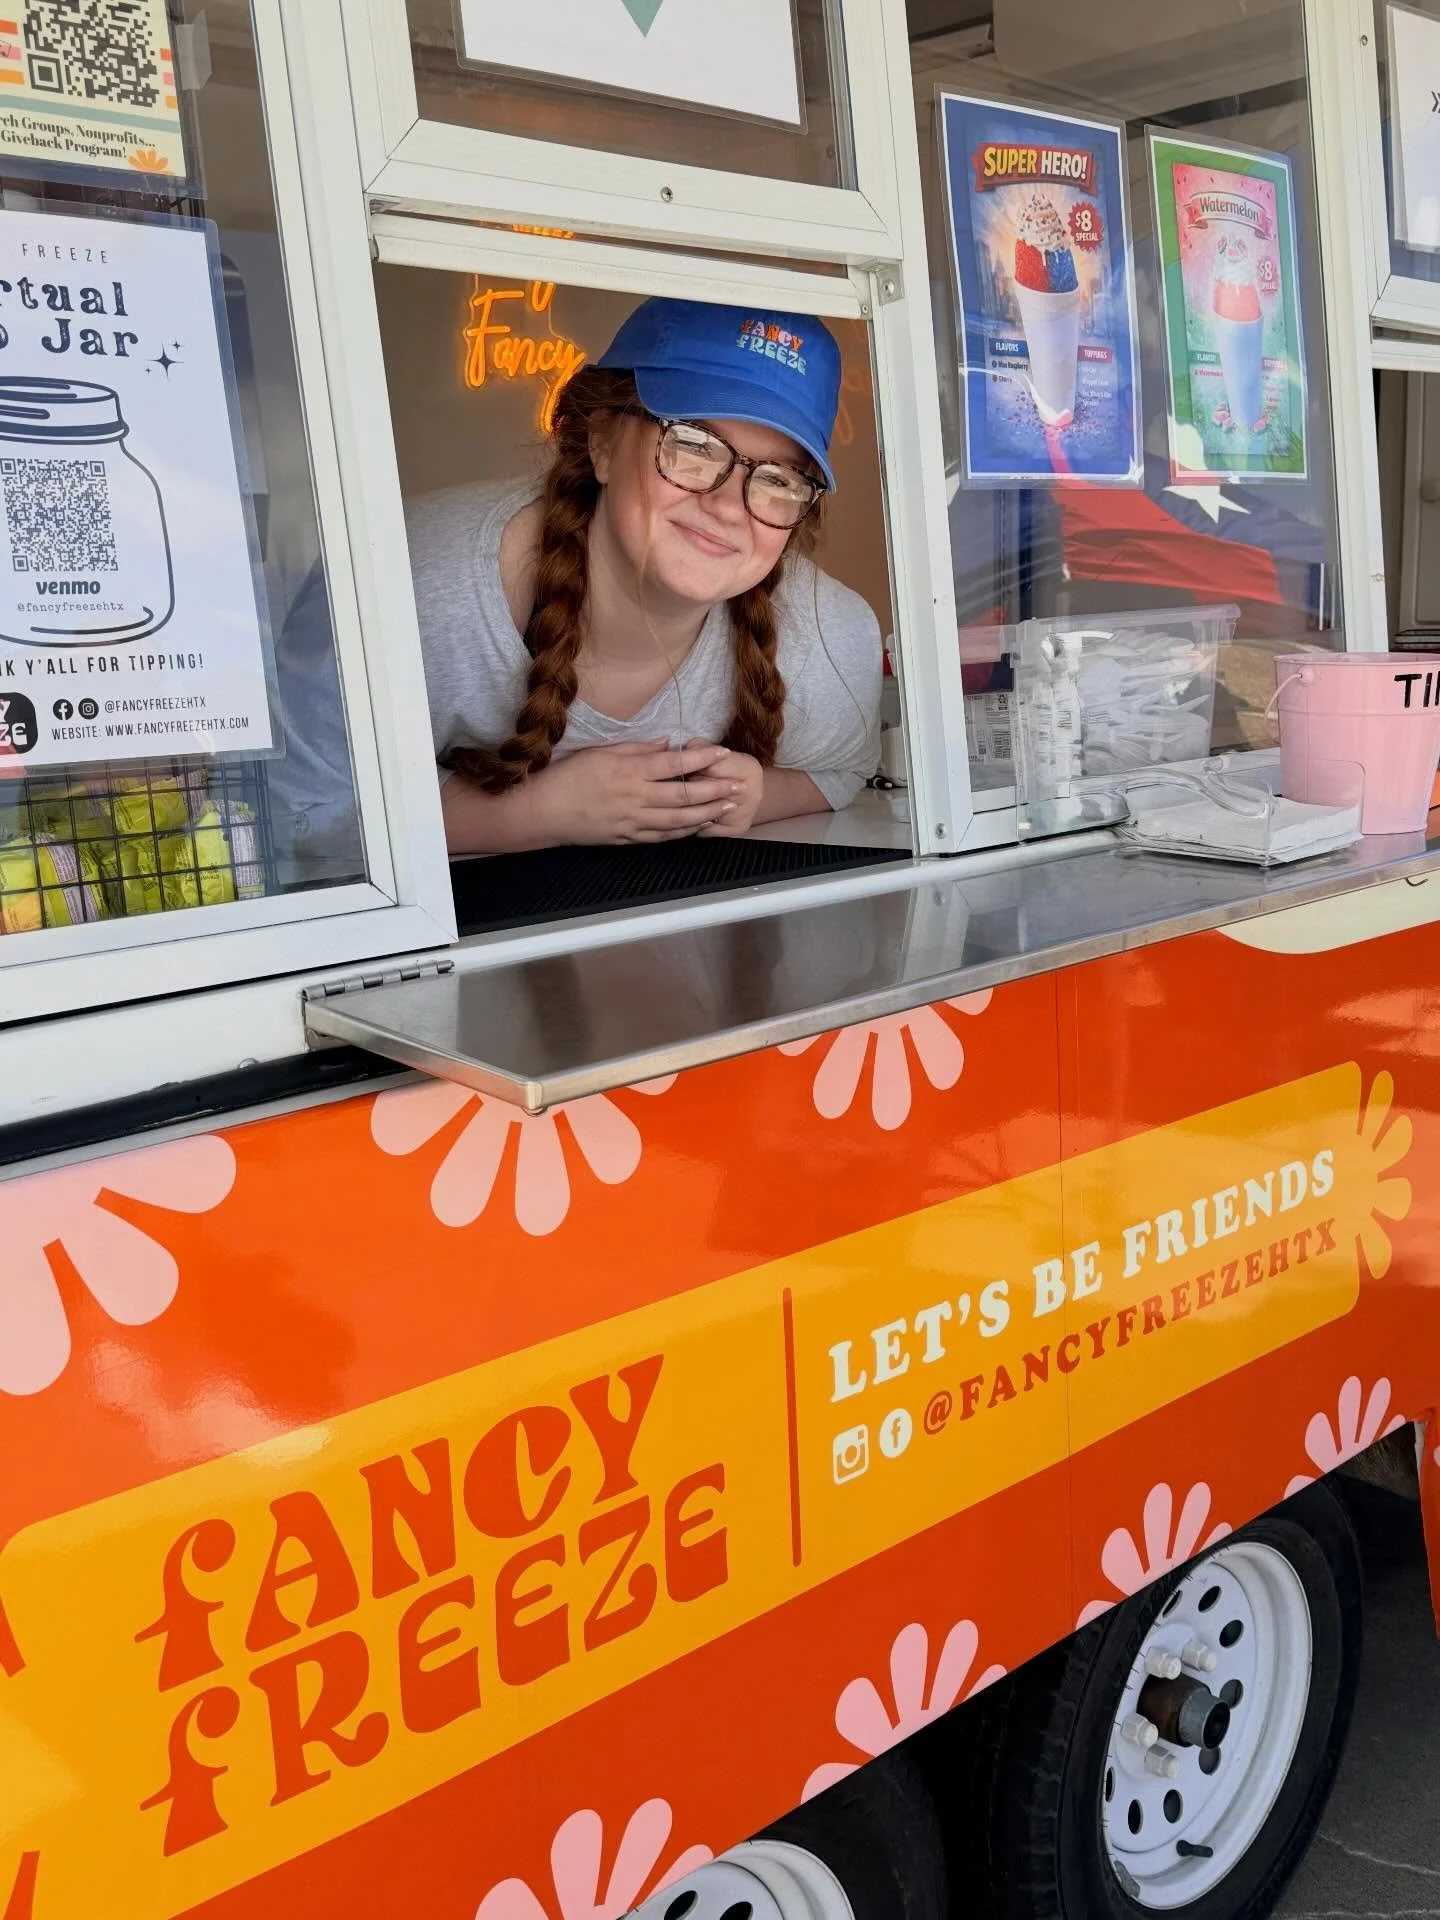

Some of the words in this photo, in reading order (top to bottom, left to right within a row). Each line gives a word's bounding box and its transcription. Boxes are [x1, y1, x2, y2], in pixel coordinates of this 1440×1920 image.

[0, 130, 64, 150] Giveback
[65, 138, 127, 158] Program!
[22, 116, 75, 139] Groups,
[76, 124, 156, 147] Nonprofits...
[983, 146, 1037, 177] SUPER
[1040, 150, 1089, 180] HERO!
[1075, 209, 1093, 232] $8
[1199, 197, 1260, 223] Watermelon
[1075, 232, 1099, 242] SPECIAL
[22, 243, 108, 264] FREEZE
[41, 317, 139, 358] Jar
[995, 342, 1019, 352] FLAVORS
[467, 288, 587, 433] Fancy
[35, 580, 101, 595] venmo
[17, 601, 125, 614] @fancyfreezehtx
[26, 657, 78, 676] Y'ALL
[87, 656, 120, 673] FOR
[129, 653, 204, 671] TIPPING!
[104, 696, 206, 714] @FANCYFREEZEHTX
[51, 725, 101, 741] WEBSITE:
[105, 716, 249, 737] WWW.FANCYFREEZEHTX.COM
[829, 1279, 1010, 1403] LET'S
[1032, 1241, 1103, 1318] BE
[1122, 1148, 1336, 1278] FRIENDS
[923, 1217, 1338, 1435] @FANCYFREEZEHTX
